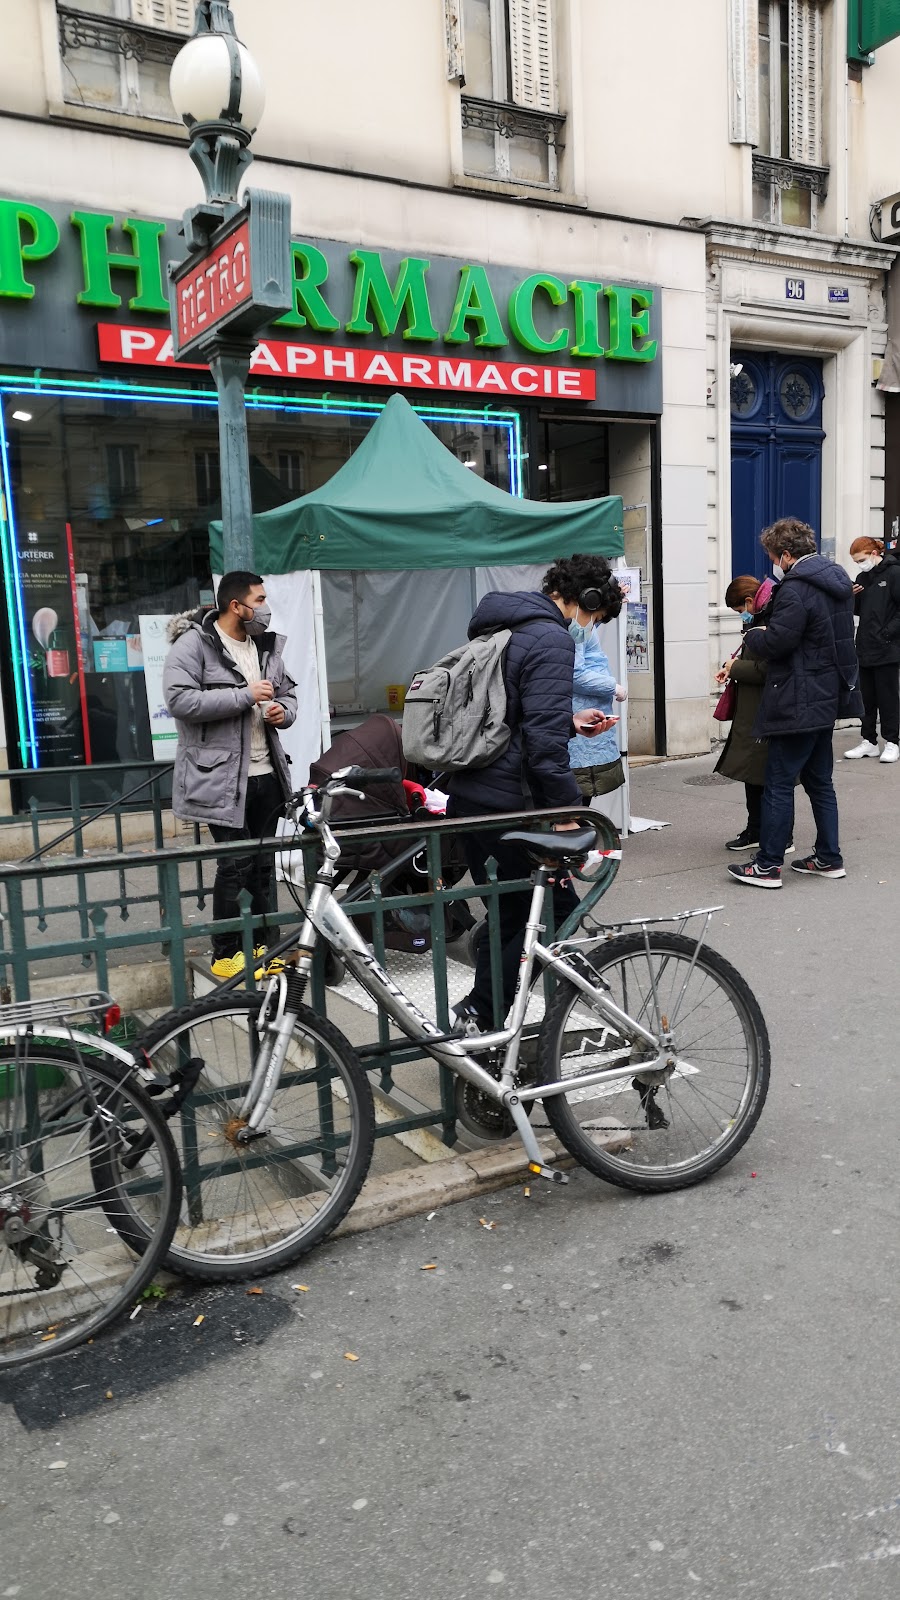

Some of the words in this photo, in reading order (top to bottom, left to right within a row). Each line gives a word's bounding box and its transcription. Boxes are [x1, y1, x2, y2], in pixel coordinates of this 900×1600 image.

[0, 198, 658, 363] PHRMACIE
[181, 240, 248, 335] METRO
[787, 280, 803, 299] 96
[120, 328, 583, 397] PAAPHARMACIE
